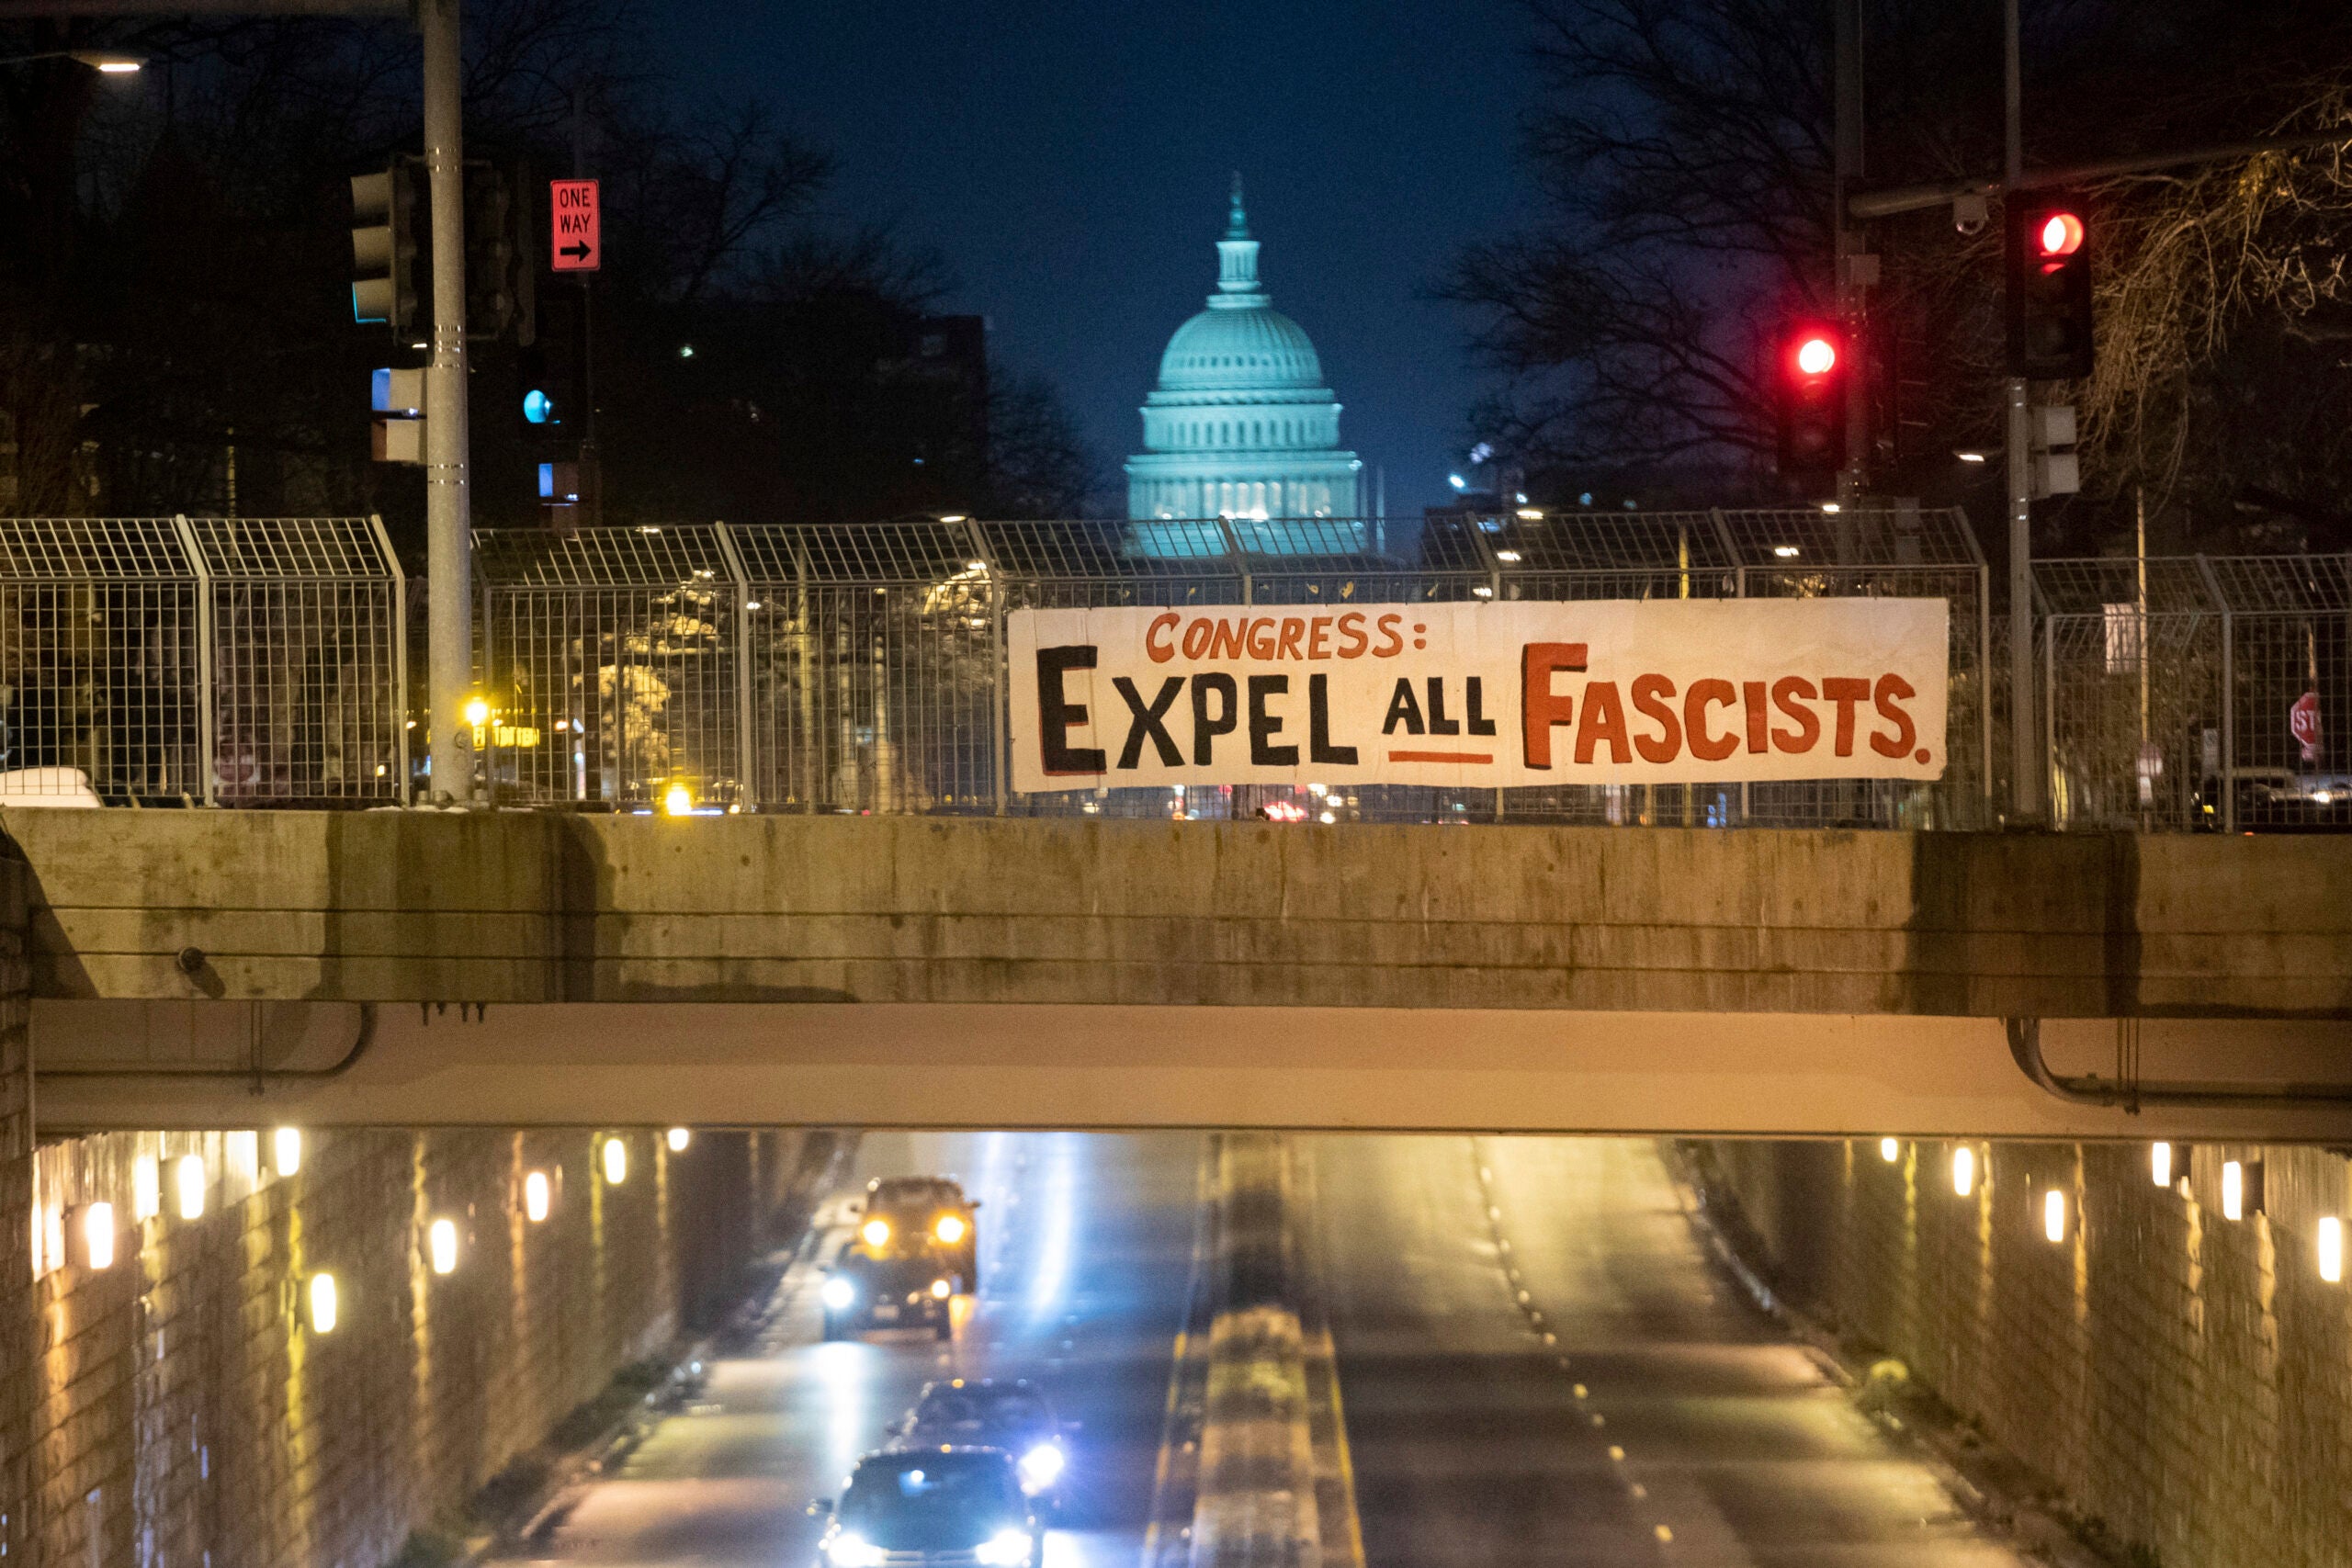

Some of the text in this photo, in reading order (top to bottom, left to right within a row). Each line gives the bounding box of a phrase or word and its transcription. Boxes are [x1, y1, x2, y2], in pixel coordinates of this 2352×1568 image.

[560, 188, 590, 208] ONE
[560, 214, 591, 233] WAY
[1146, 612, 1427, 663] CONGRESS:
[1036, 642, 1931, 776] EXPEL ALL FASCISTS.
